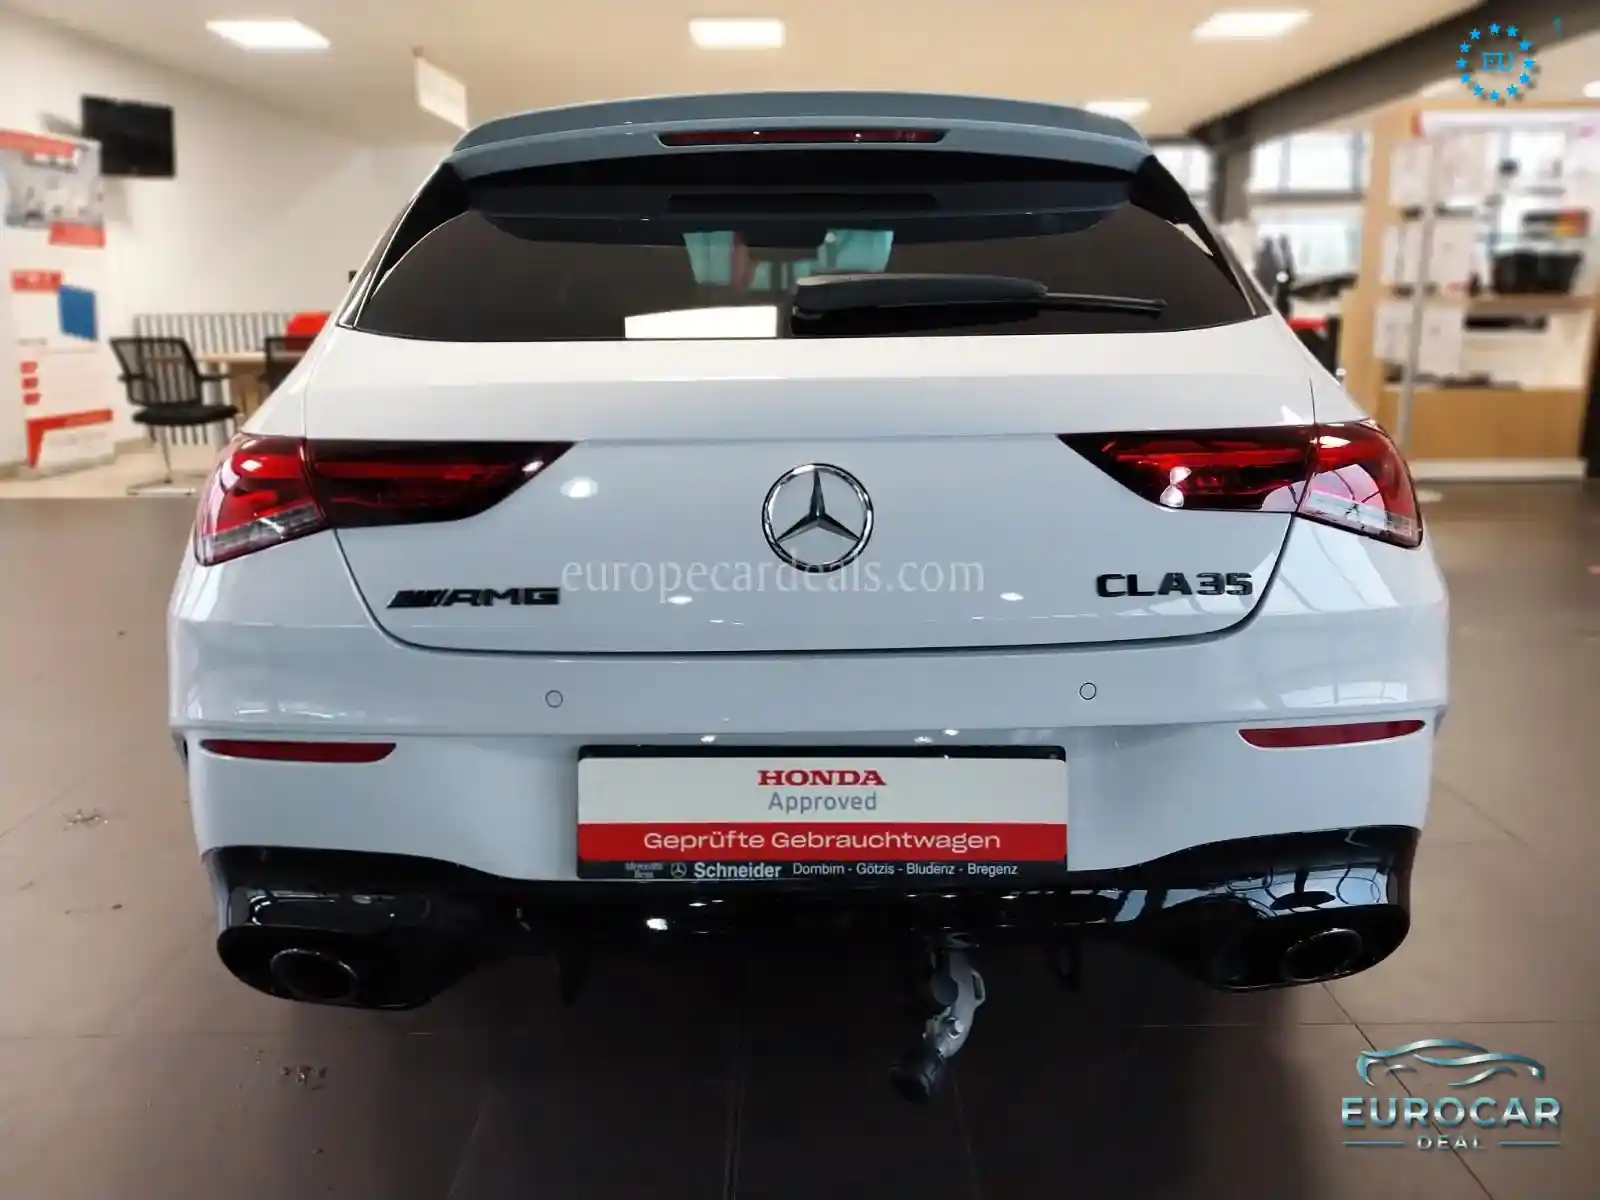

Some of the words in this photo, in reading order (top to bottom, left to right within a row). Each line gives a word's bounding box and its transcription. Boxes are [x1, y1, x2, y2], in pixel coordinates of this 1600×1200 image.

[756, 769, 887, 787] HONDA
[768, 792, 878, 814] Approved
[643, 830, 766, 853] Geprüfte
[771, 831, 1001, 854] Gebrauchtwagen
[693, 861, 782, 878] Schneider
[856, 862, 895, 875] Götzis
[906, 862, 955, 875] Bludenz
[967, 862, 1018, 877] Bregenz
